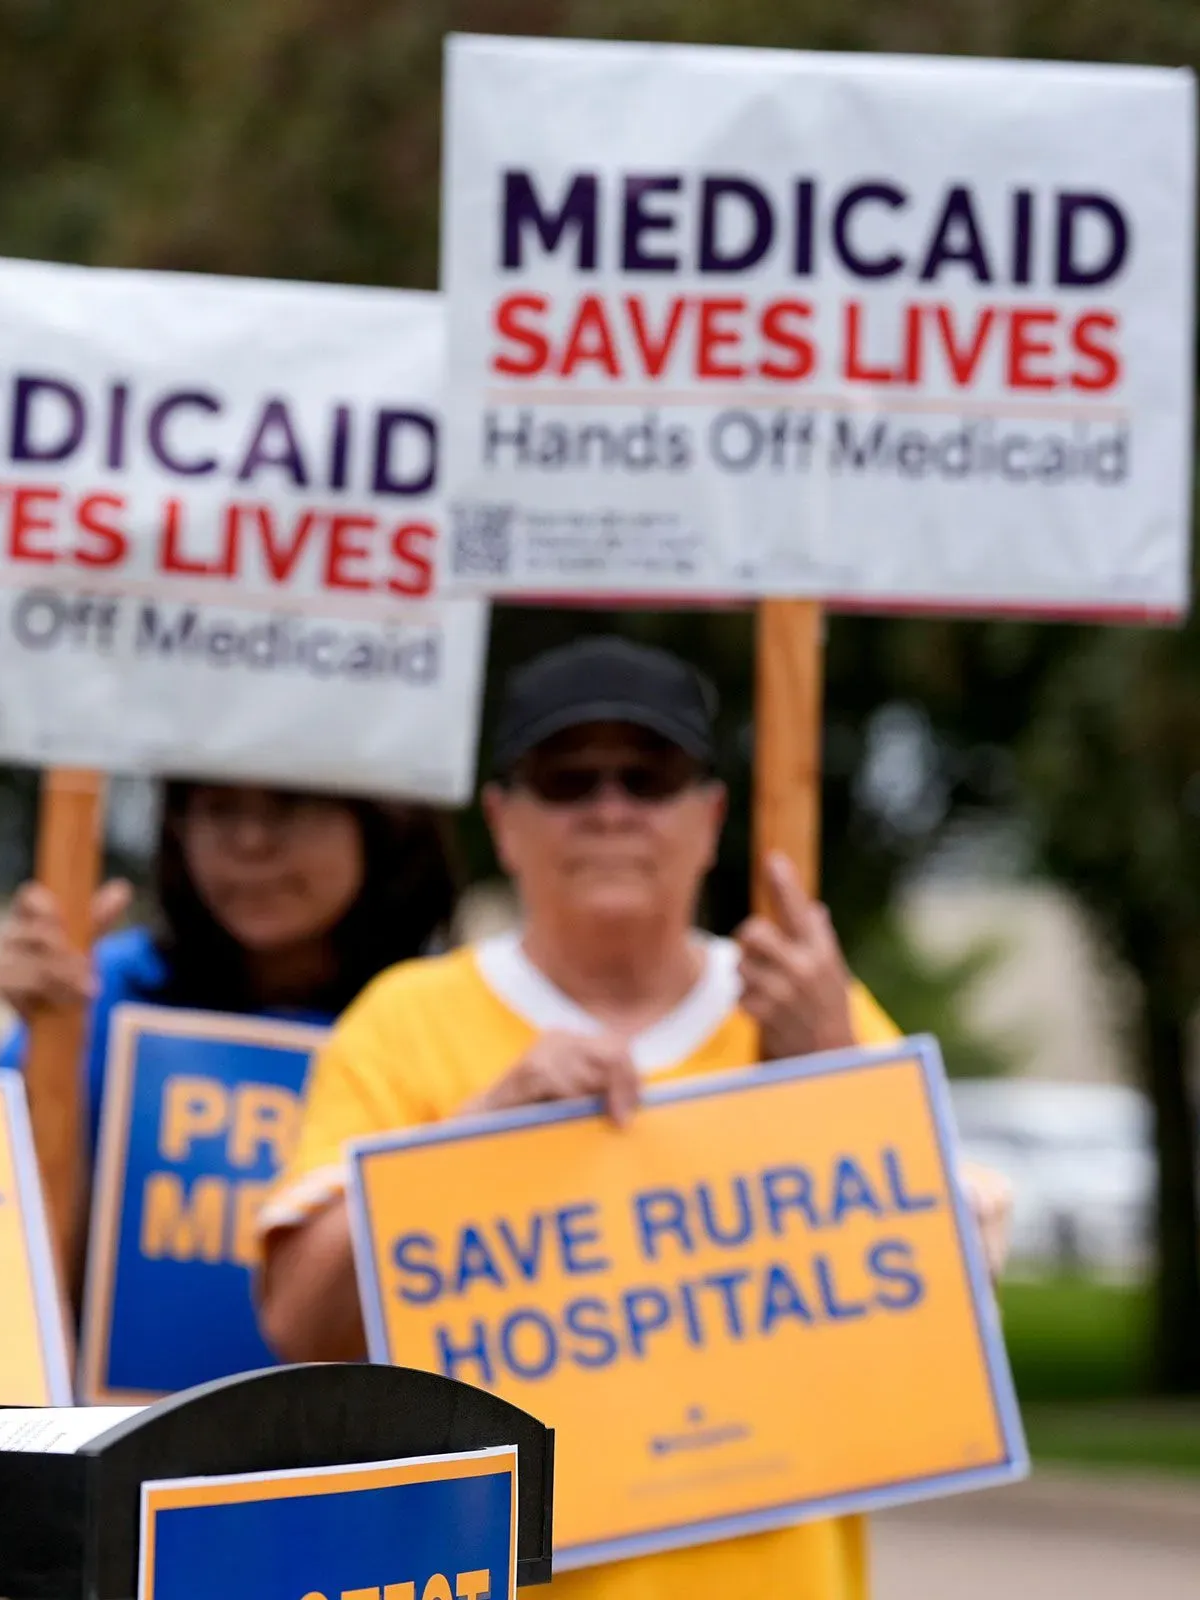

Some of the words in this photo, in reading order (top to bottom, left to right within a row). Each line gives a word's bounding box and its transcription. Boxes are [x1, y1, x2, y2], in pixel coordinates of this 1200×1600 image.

[501, 169, 1130, 288] MEDICAID
[491, 291, 816, 381] SAVES
[843, 302, 1121, 392] LIVES
[482, 412, 692, 473] Hands
[709, 411, 815, 475] Off
[831, 418, 1131, 486] Medicaid
[159, 500, 438, 599] LIVES
[11, 588, 116, 655] Off
[135, 606, 442, 684] Medicaid
[391, 1204, 608, 1304] SAVE
[633, 1147, 936, 1259] RURAL
[436, 1240, 924, 1386] HOSPITALS
